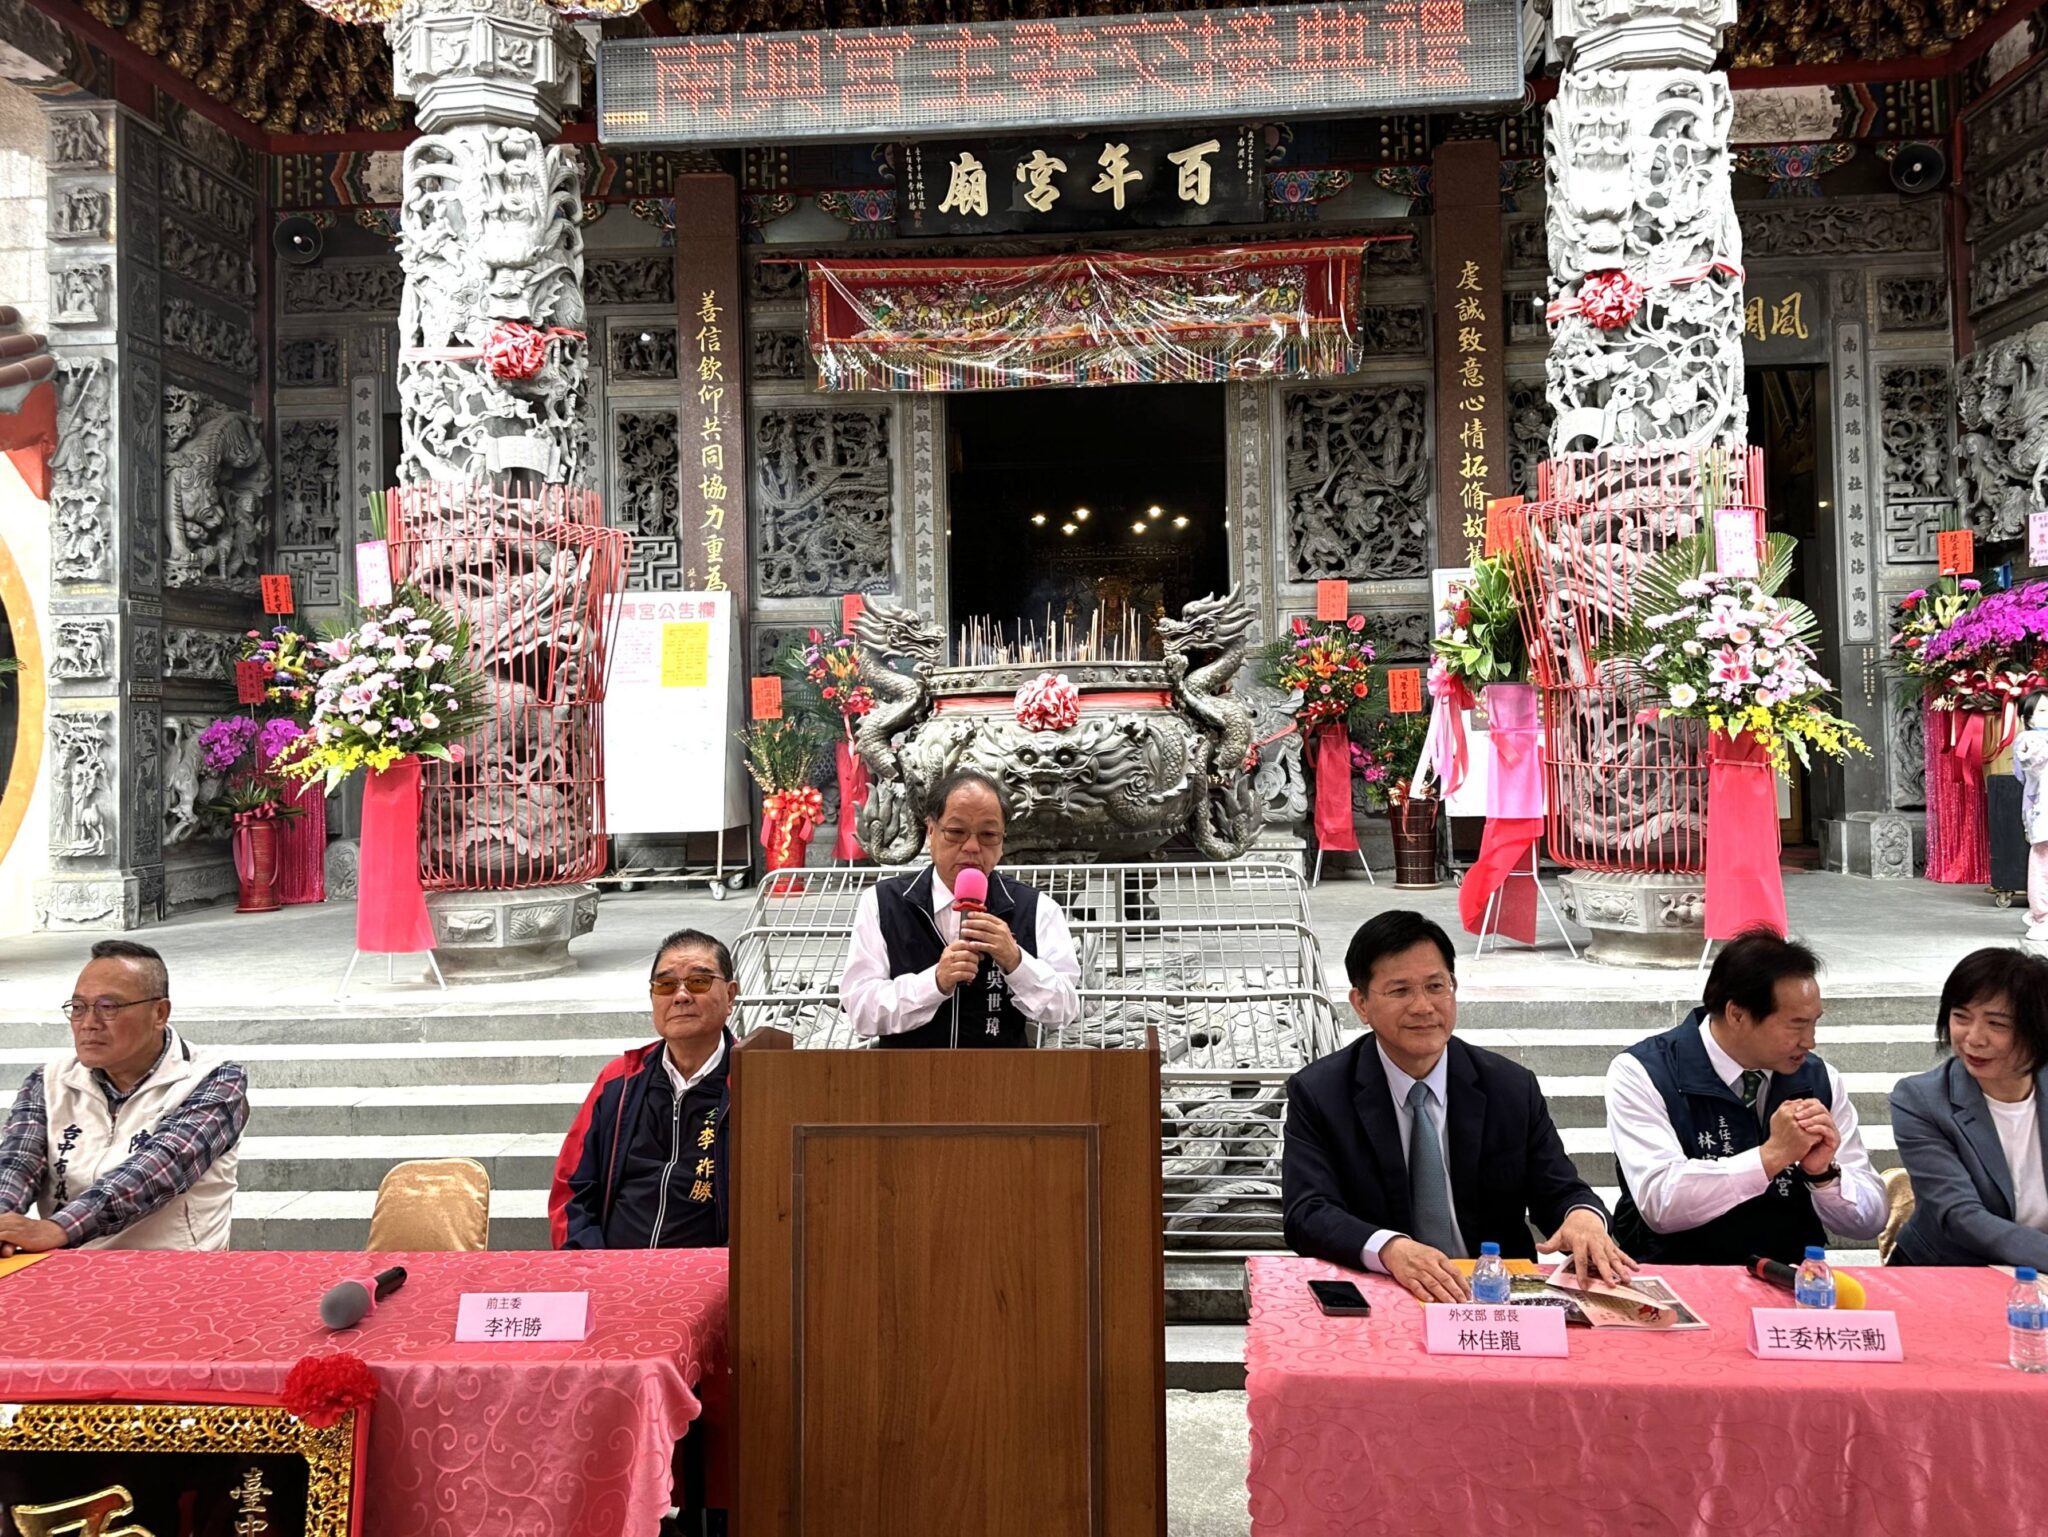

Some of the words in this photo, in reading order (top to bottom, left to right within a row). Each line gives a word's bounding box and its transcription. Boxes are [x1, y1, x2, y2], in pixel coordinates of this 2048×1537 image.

[652, 0, 1472, 122] 南興宮主委交接典禮
[689, 1127, 715, 1203] 李祚勝
[486, 1297, 522, 1310] 前主委
[1449, 1309, 1487, 1322] 外交部
[1494, 1309, 1520, 1322] 部長
[484, 1317, 542, 1338] 李祚勝
[1458, 1330, 1521, 1351] 林佳龍
[1767, 1326, 1886, 1351] 主委林宗勳
